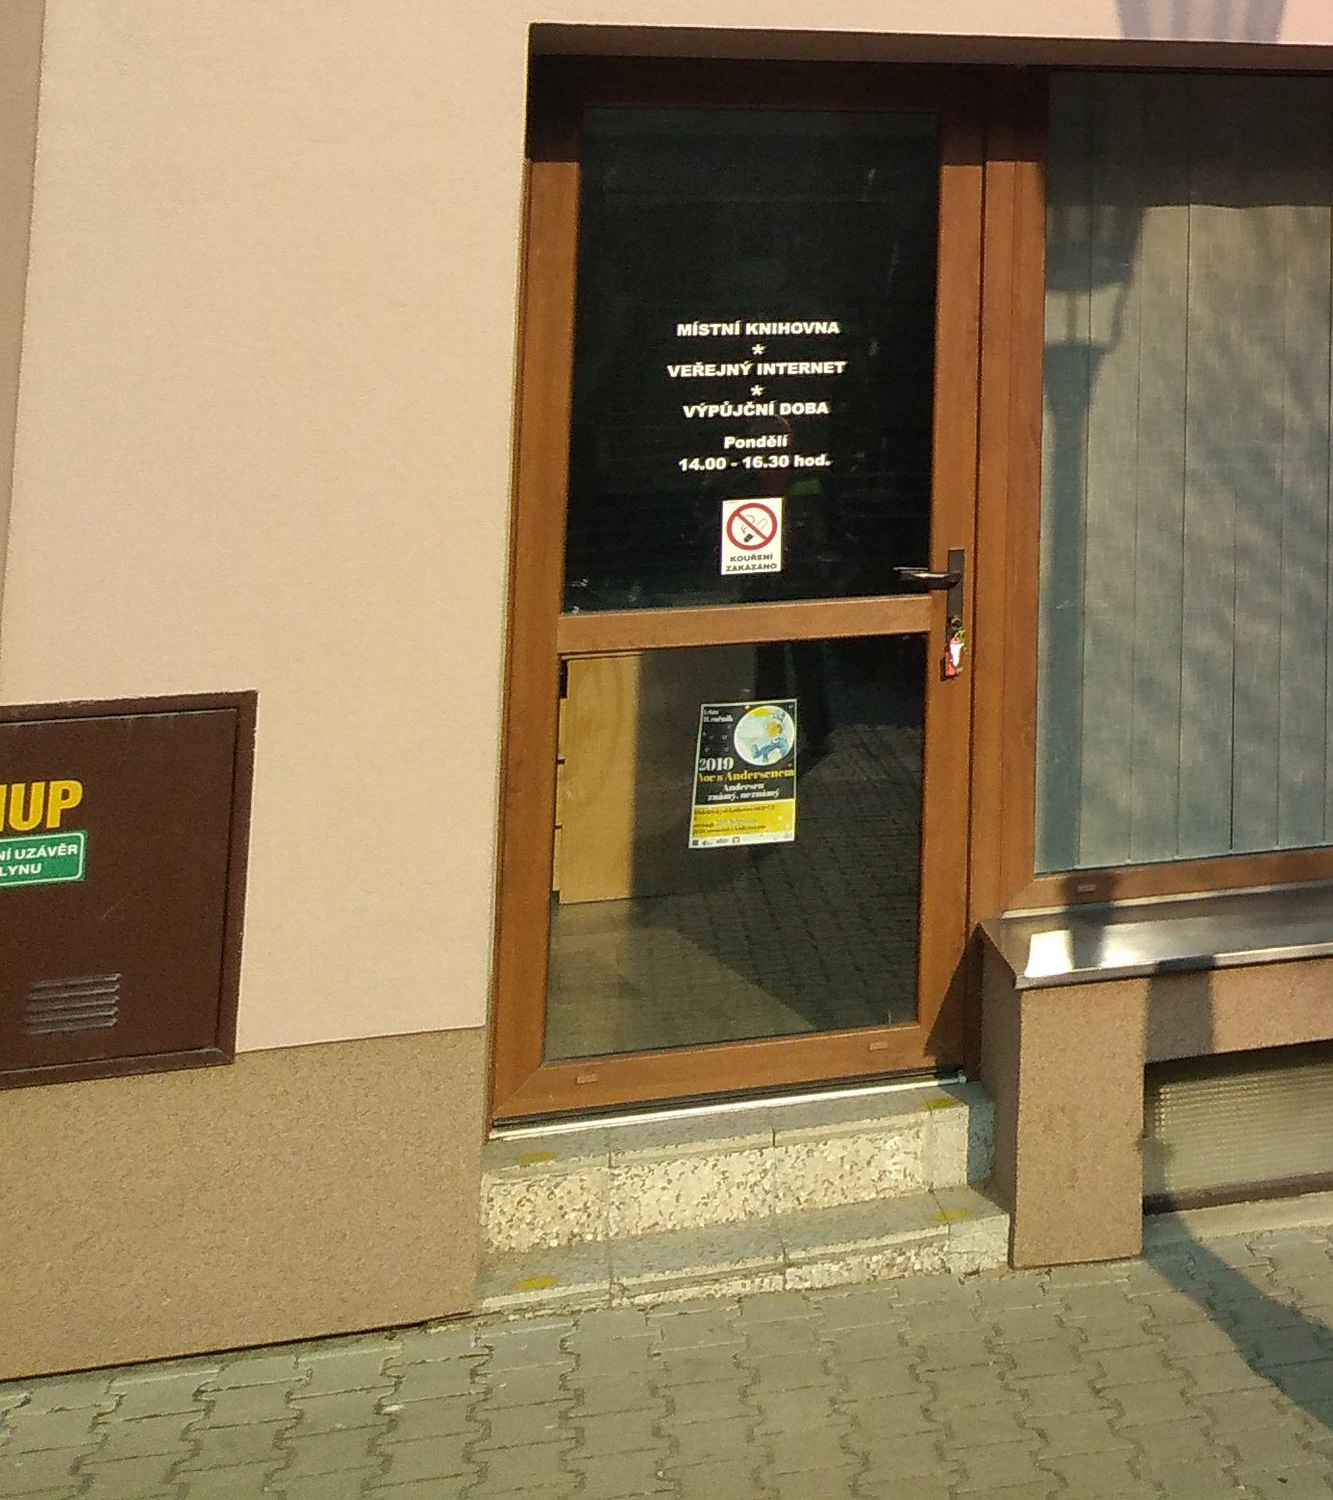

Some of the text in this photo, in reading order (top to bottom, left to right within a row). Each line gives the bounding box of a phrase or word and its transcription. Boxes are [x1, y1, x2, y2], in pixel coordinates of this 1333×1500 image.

[676, 320, 841, 337] MÍSTNÍ KNIHOVNA
[666, 360, 848, 378] VEŘEJNÝ INTERNET
[682, 400, 830, 419] VÝPŮJČNÍ DOBA
[723, 434, 789, 450] Pondělí
[678, 456, 727, 472] 14.00
[741, 454, 790, 469] 16.30
[793, 453, 832, 468] hod.
[729, 552, 774, 563] KOUŘENÍ
[725, 562, 778, 572] ZAKÁZÁNO
[699, 757, 734, 770] 2019
[0, 780, 83, 831] UP
[14, 842, 78, 860] UZÁVĚR
[0, 863, 42, 877] LYNU
